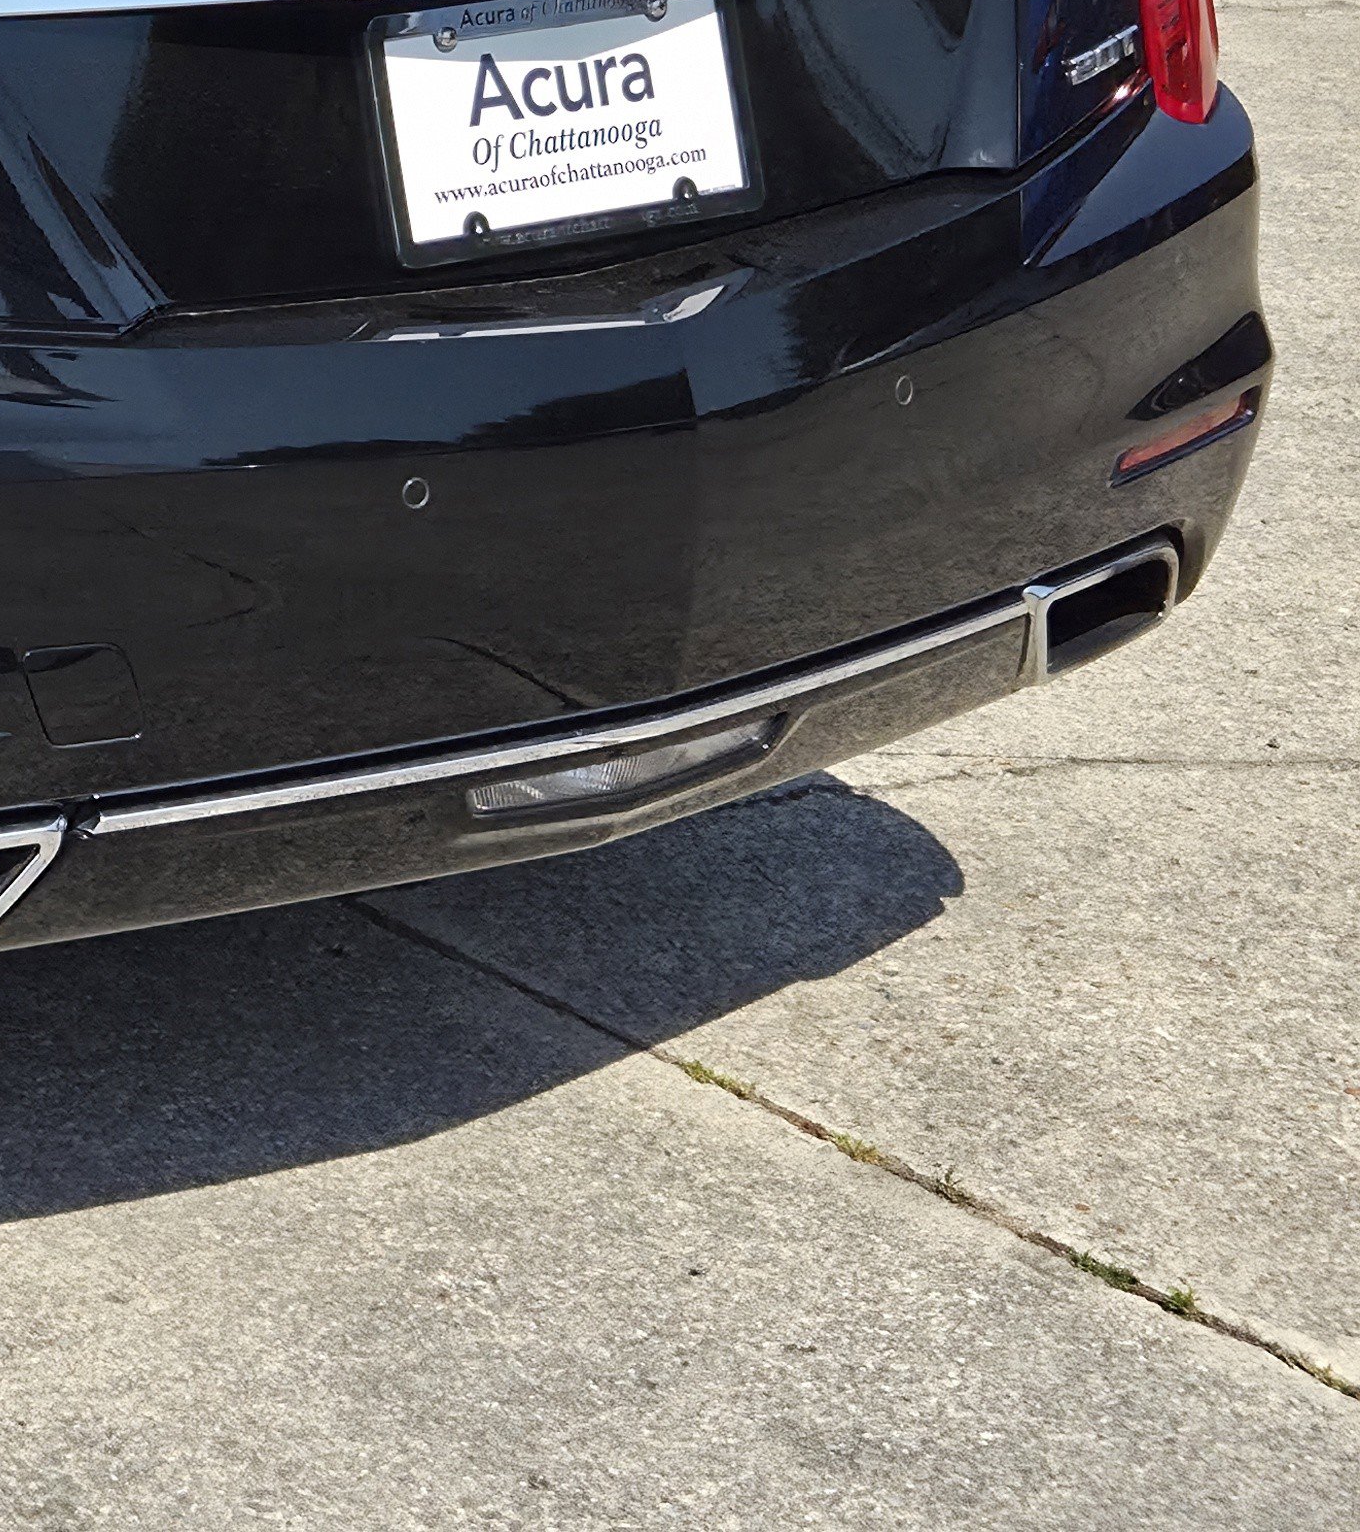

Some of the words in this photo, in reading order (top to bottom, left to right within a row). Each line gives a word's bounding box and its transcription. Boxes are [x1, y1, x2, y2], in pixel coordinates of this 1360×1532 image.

[460, 8, 515, 30] Acura
[520, 1, 538, 24] of
[469, 52, 656, 128] Acura
[472, 134, 502, 173] Of
[509, 119, 662, 160] Chattanooga
[434, 148, 707, 204] www.acuraofchattanooga.com
